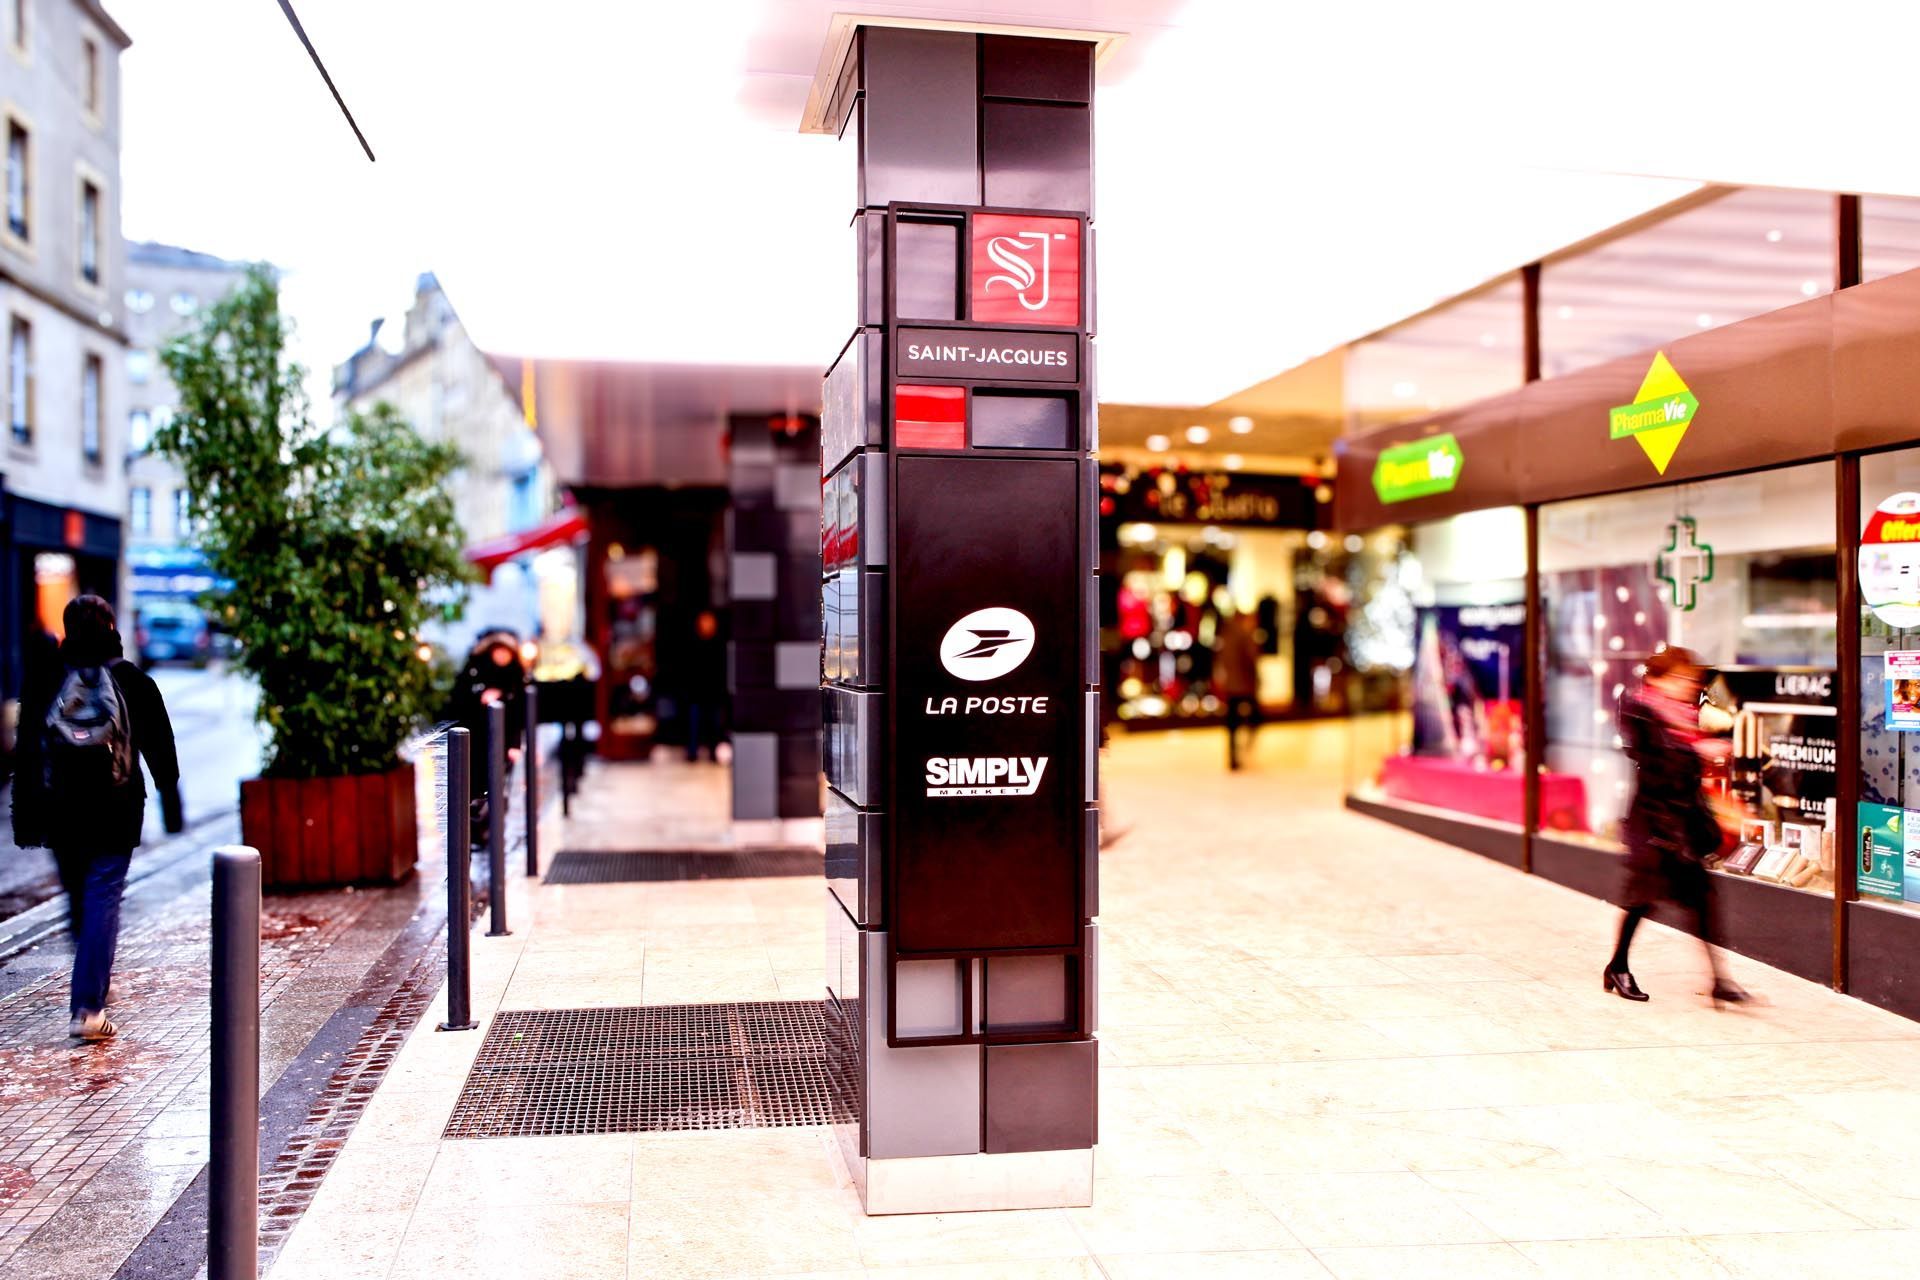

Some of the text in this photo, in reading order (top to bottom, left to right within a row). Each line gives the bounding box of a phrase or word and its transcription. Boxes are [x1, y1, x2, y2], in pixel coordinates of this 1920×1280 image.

[907, 344, 1069, 367] SAINT-JACQUES
[1612, 397, 1688, 434] PharmaVie
[925, 696, 1049, 715] LA POSTE
[1769, 742, 1837, 765] PREMIUM
[939, 788, 1021, 796] MARKET
